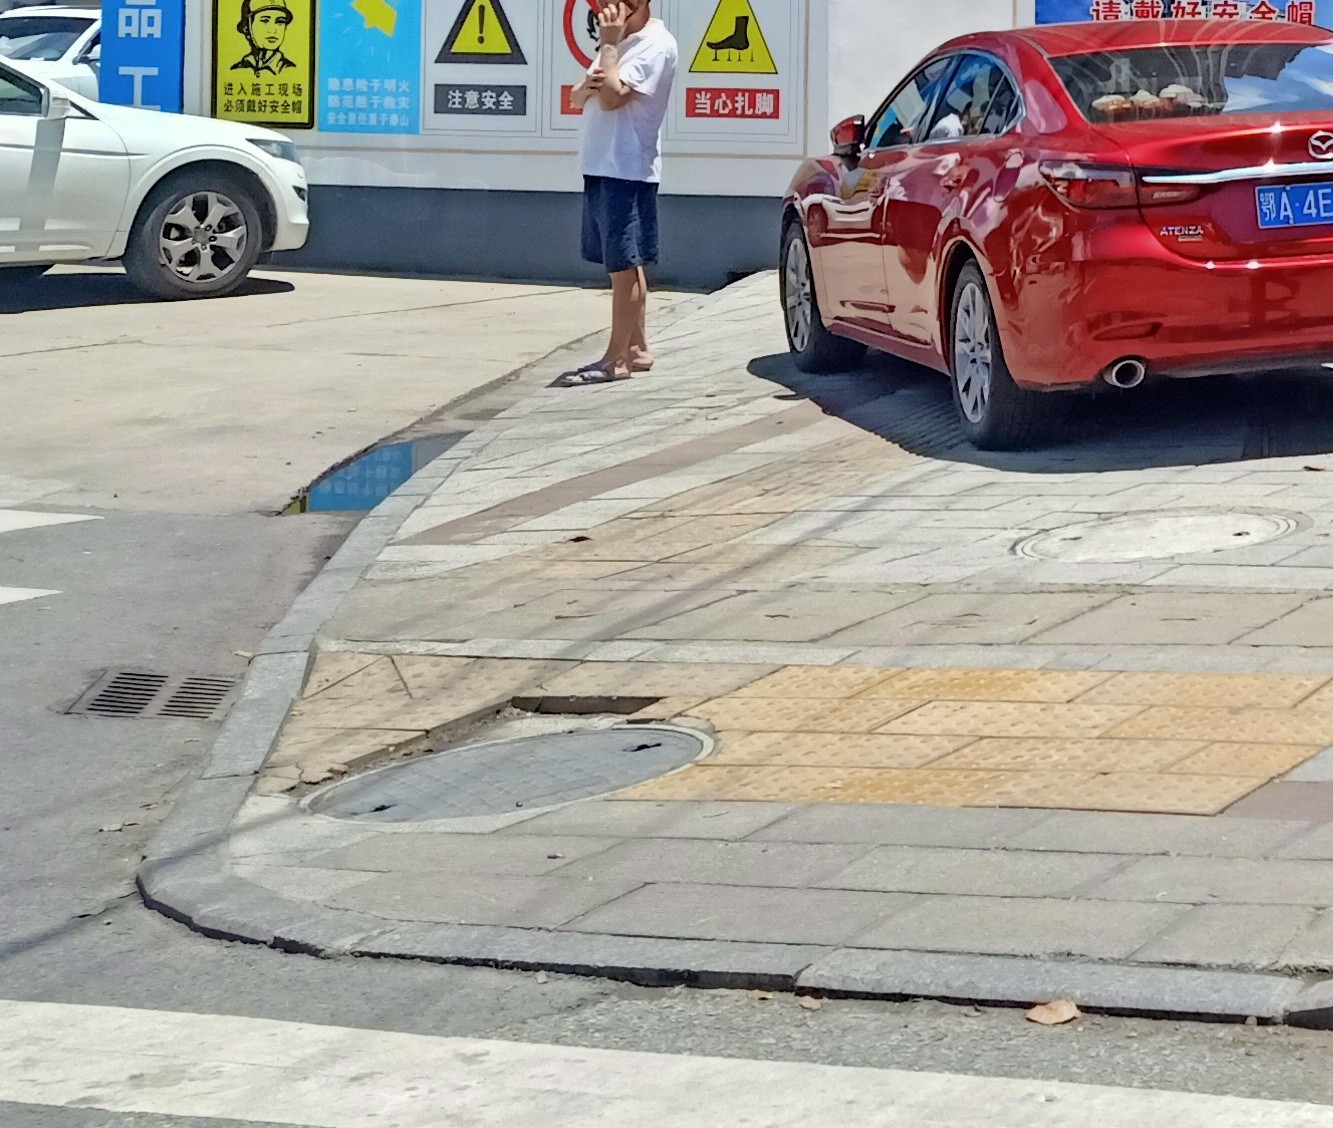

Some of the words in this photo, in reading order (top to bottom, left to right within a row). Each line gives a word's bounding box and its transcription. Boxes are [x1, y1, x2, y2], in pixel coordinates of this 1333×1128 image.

[223, 83, 303, 97] 进入施工现场
[223, 99, 303, 114] 必须戴好安全帽
[446, 89, 515, 111] 注意安全
[694, 91, 774, 116] 当心扎脚
[1159, 225, 1204, 237] ATENZA
